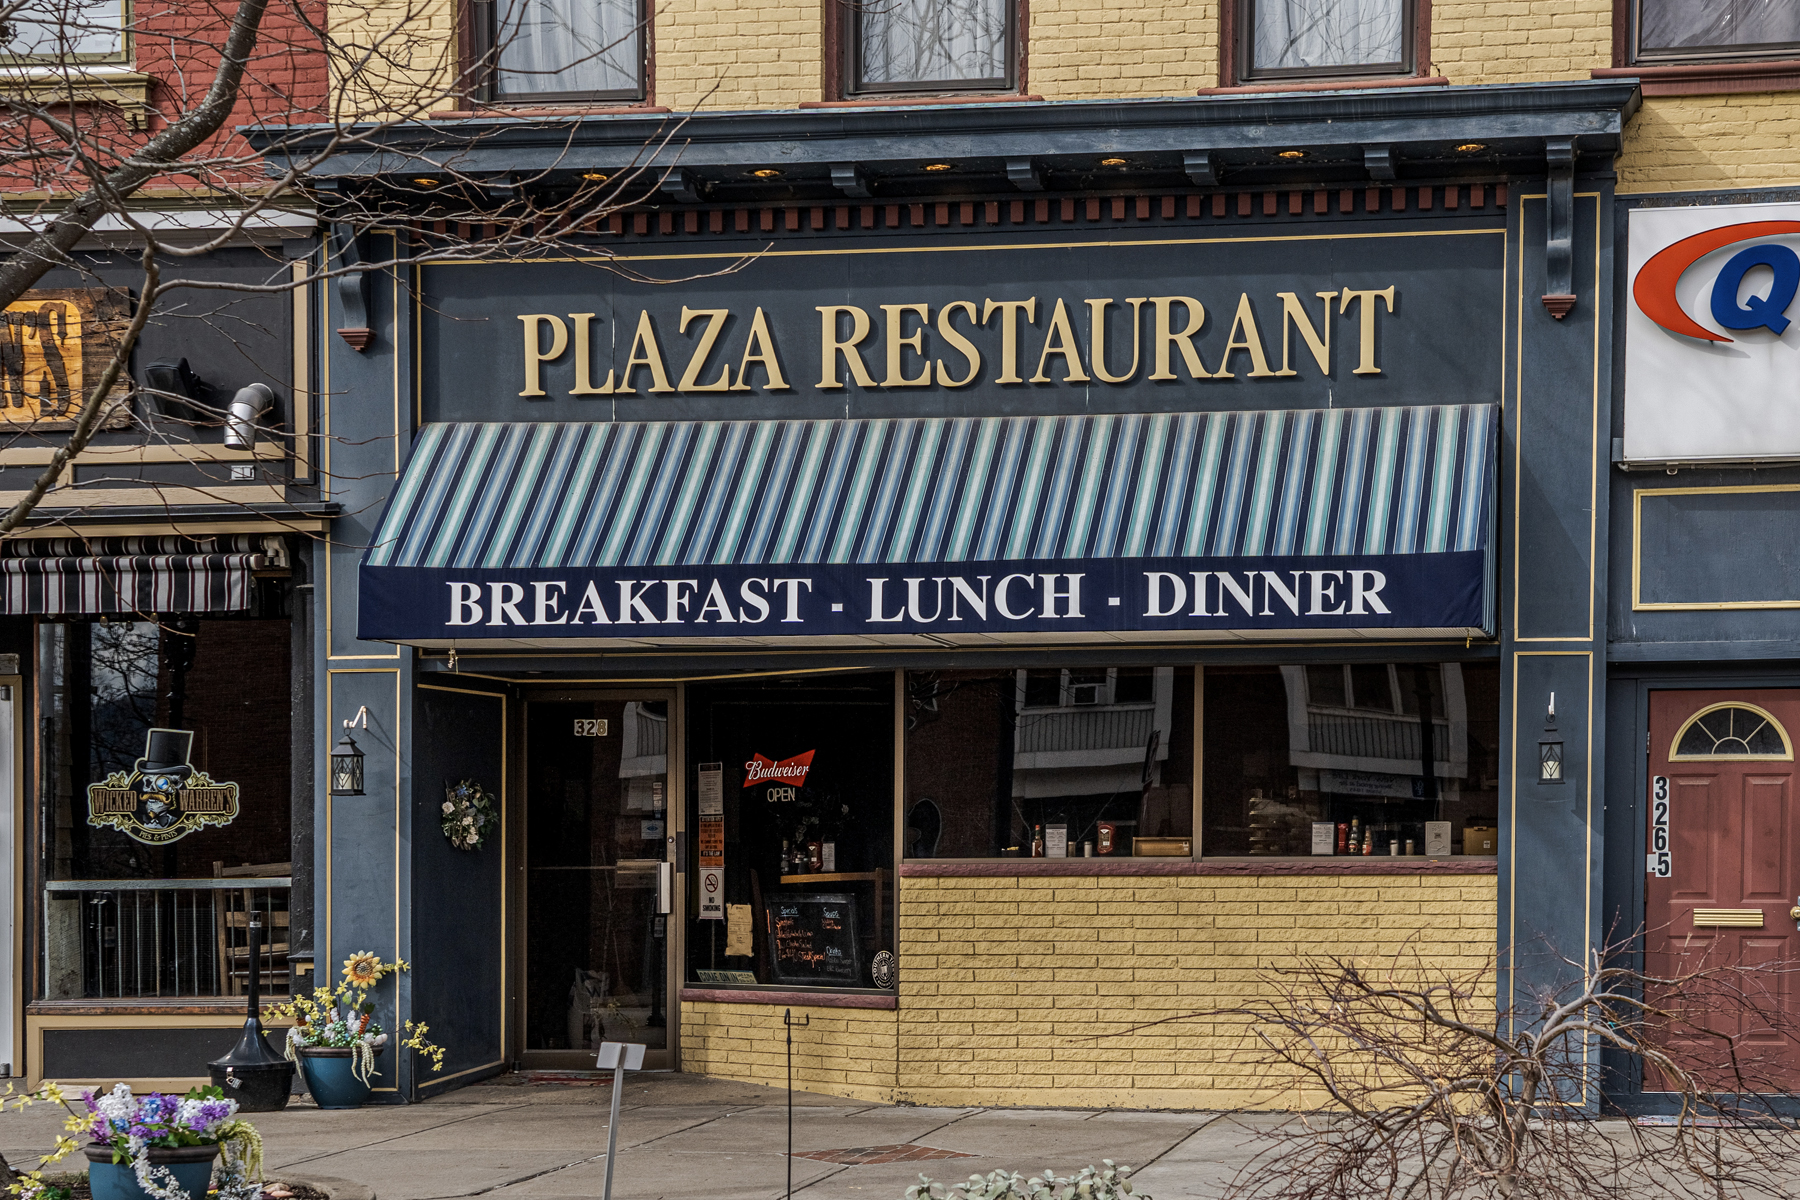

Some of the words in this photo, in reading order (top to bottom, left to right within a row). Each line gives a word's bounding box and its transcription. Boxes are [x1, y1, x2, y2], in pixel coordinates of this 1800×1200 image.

[1711, 244, 1800, 336] Q
[517, 305, 790, 397] PLAZA
[815, 285, 1395, 388] RESTAURANT
[445, 577, 812, 627] BREAKFAST
[866, 573, 1086, 623] LUNCH
[1143, 570, 1392, 618] DINNER
[575, 719, 607, 736] 328
[745, 760, 810, 780] Budweiser
[93, 789, 138, 814] WICKED
[179, 788, 235, 813] WARREN'S
[767, 787, 796, 803] OPEN
[138, 830, 152, 840] PIES
[154, 833, 160, 841] &
[160, 830, 178, 841] PINTS
[702, 904, 721, 912] SMOKING
[708, 896, 715, 904] NO
[699, 971, 720, 982] COME
[719, 972, 731, 982] ON
